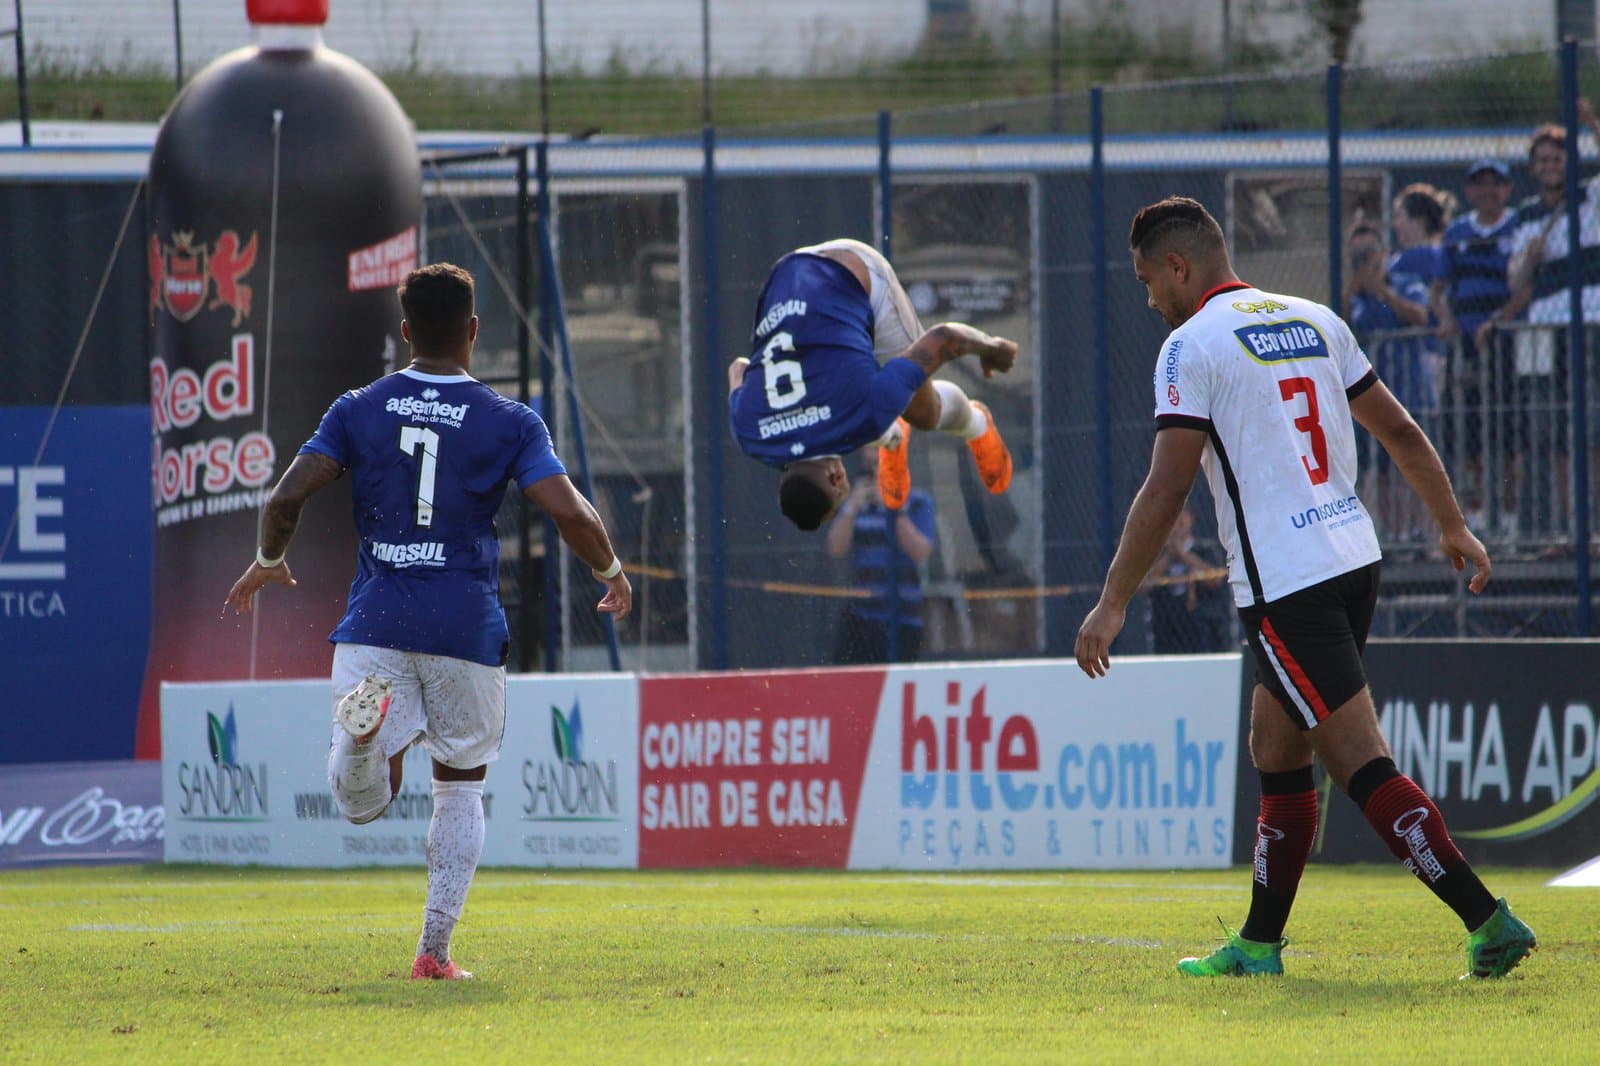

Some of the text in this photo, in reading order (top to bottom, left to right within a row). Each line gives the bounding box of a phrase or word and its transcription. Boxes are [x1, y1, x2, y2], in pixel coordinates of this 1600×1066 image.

[1166, 339, 1181, 383] KRONA
[1248, 326, 1319, 355] Ecoville
[150, 333, 254, 432] Red
[385, 396, 467, 422] agemed
[1278, 377, 1329, 486] 3
[400, 426, 439, 526] 7
[642, 716, 831, 769] COMPRE SEM
[1521, 703, 1600, 806] AP
[178, 760, 269, 817] SANDRINI
[521, 759, 619, 815] SANDRINI
[642, 778, 848, 830] SAIR DE CASA
[899, 817, 1228, 865] PEÇAS & TINTAS
[1408, 823, 1447, 880] WALBERT
